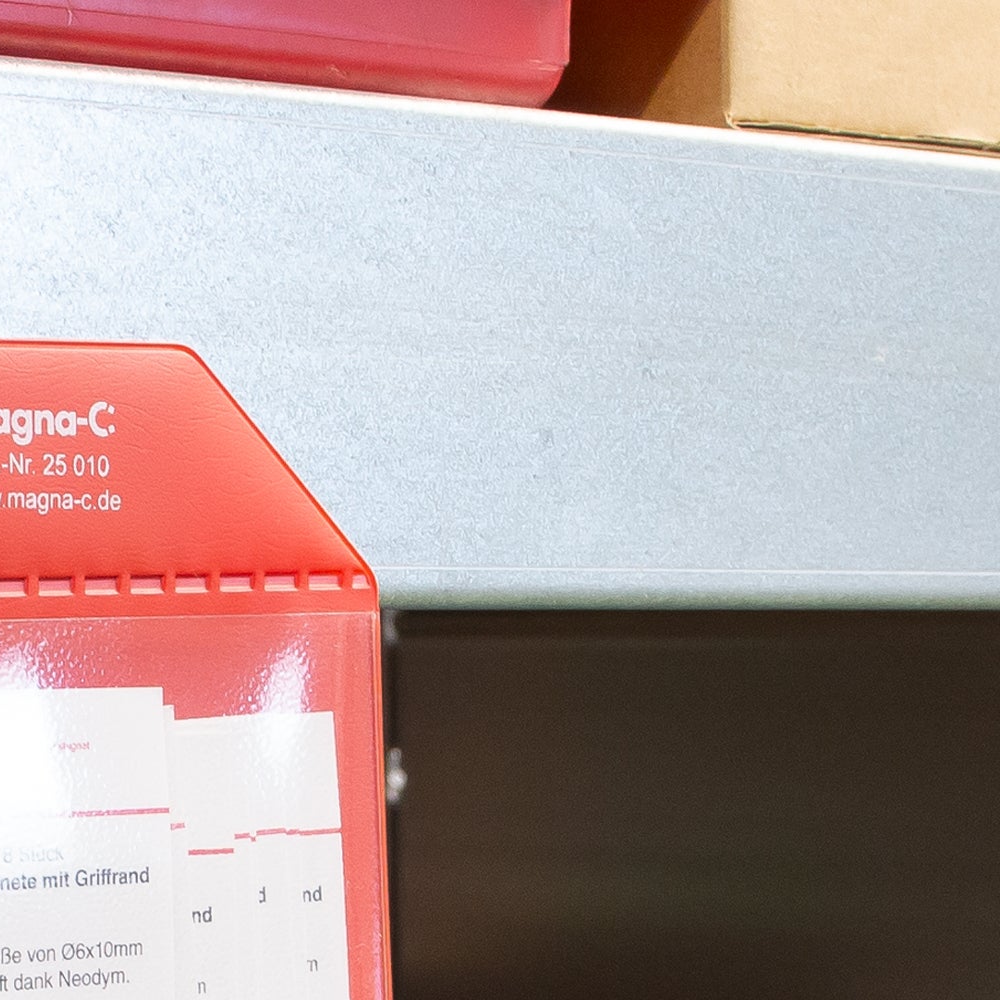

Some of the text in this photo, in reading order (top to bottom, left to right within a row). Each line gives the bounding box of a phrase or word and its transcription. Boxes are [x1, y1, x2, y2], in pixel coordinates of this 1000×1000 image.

[42, 453, 67, 476] 25
[73, 454, 110, 478] 010
[42, 872, 70, 889] mit
[74, 866, 151, 887] Griffrand
[27, 945, 56, 963] von
[61, 940, 144, 962] Ø6x10mm
[12, 970, 53, 992] dank
[58, 967, 131, 990] Neodym.
